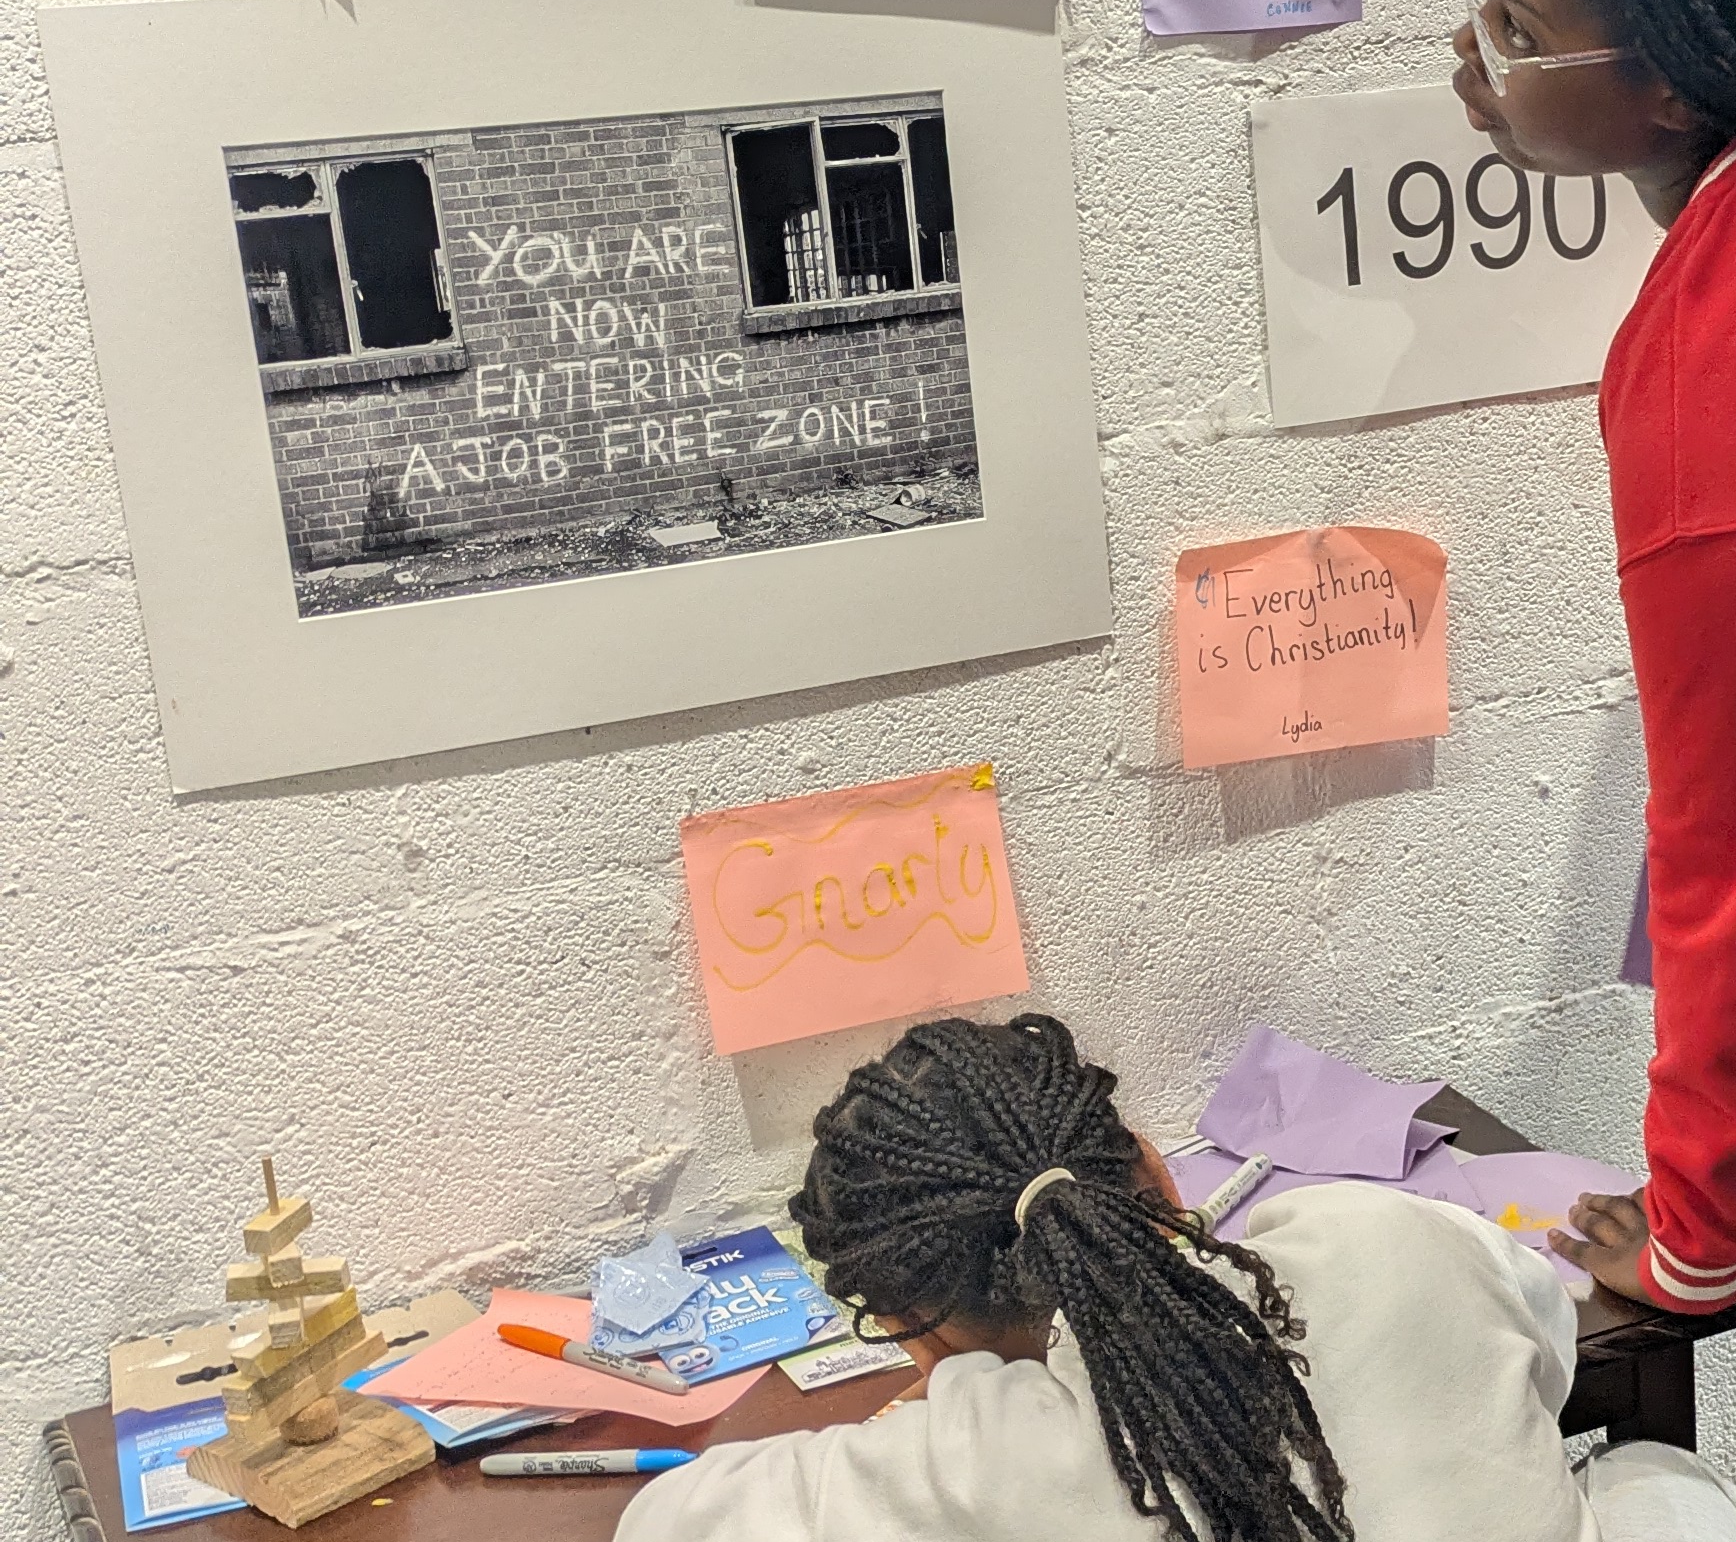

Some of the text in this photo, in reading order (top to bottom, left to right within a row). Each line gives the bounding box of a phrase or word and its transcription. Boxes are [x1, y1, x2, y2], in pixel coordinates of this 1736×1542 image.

[1316, 152, 1607, 287] 1990
[468, 223, 734, 285] YOU ARE
[549, 297, 667, 348] NOW
[474, 352, 749, 420] ENTERING
[399, 444, 446, 498] A
[452, 435, 568, 483] JOB
[602, 410, 738, 476] FREE
[754, 398, 891, 451] ZONE
[1223, 558, 1394, 627] Everything
[1198, 599, 1419, 673] is Christianity!
[1282, 711, 1323, 743] Lydia
[713, 813, 998, 955] Gnarly
[683, 1249, 745, 1273] STIK
[711, 1274, 757, 1299] lu
[709, 1287, 788, 1323] ack
